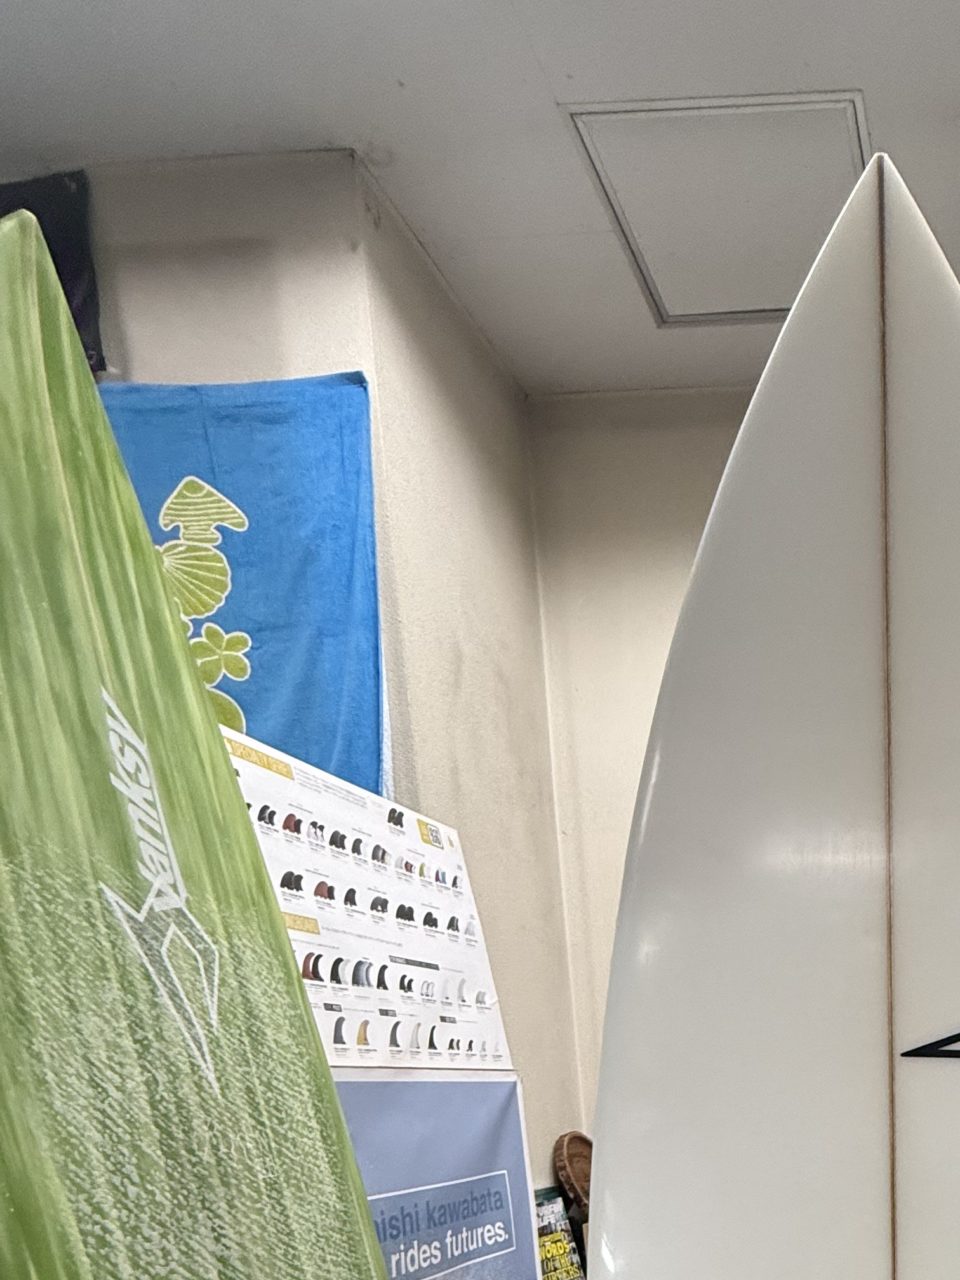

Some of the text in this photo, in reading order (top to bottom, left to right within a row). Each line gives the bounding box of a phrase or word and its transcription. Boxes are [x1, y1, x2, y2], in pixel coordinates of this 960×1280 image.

[425, 1188, 504, 1231] kawabata
[390, 1221, 509, 1278] rides futures.
